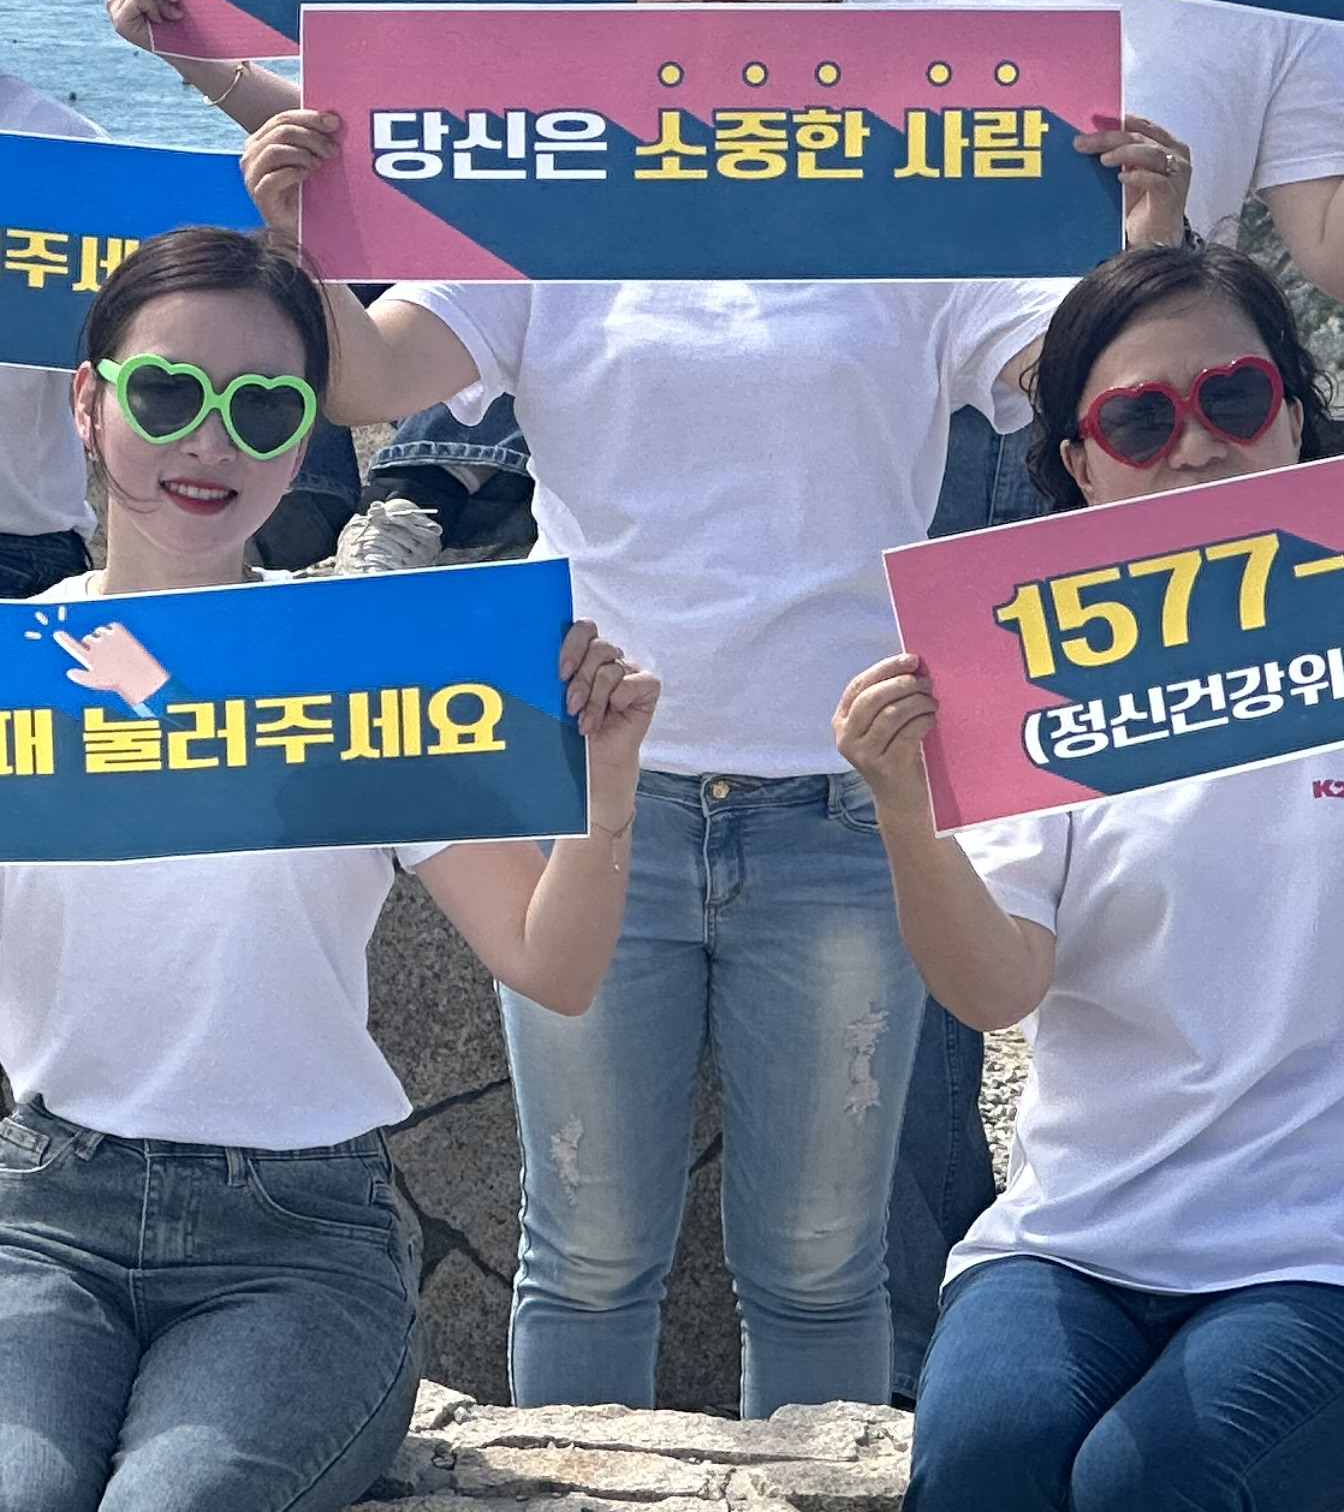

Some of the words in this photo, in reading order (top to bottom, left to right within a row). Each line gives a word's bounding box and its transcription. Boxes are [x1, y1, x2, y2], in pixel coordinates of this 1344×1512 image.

[372, 110, 608, 180] 당신은
[634, 110, 870, 180] 소중한
[894, 110, 1049, 179] 사람
[83, 683, 506, 773] 눌러주세요
